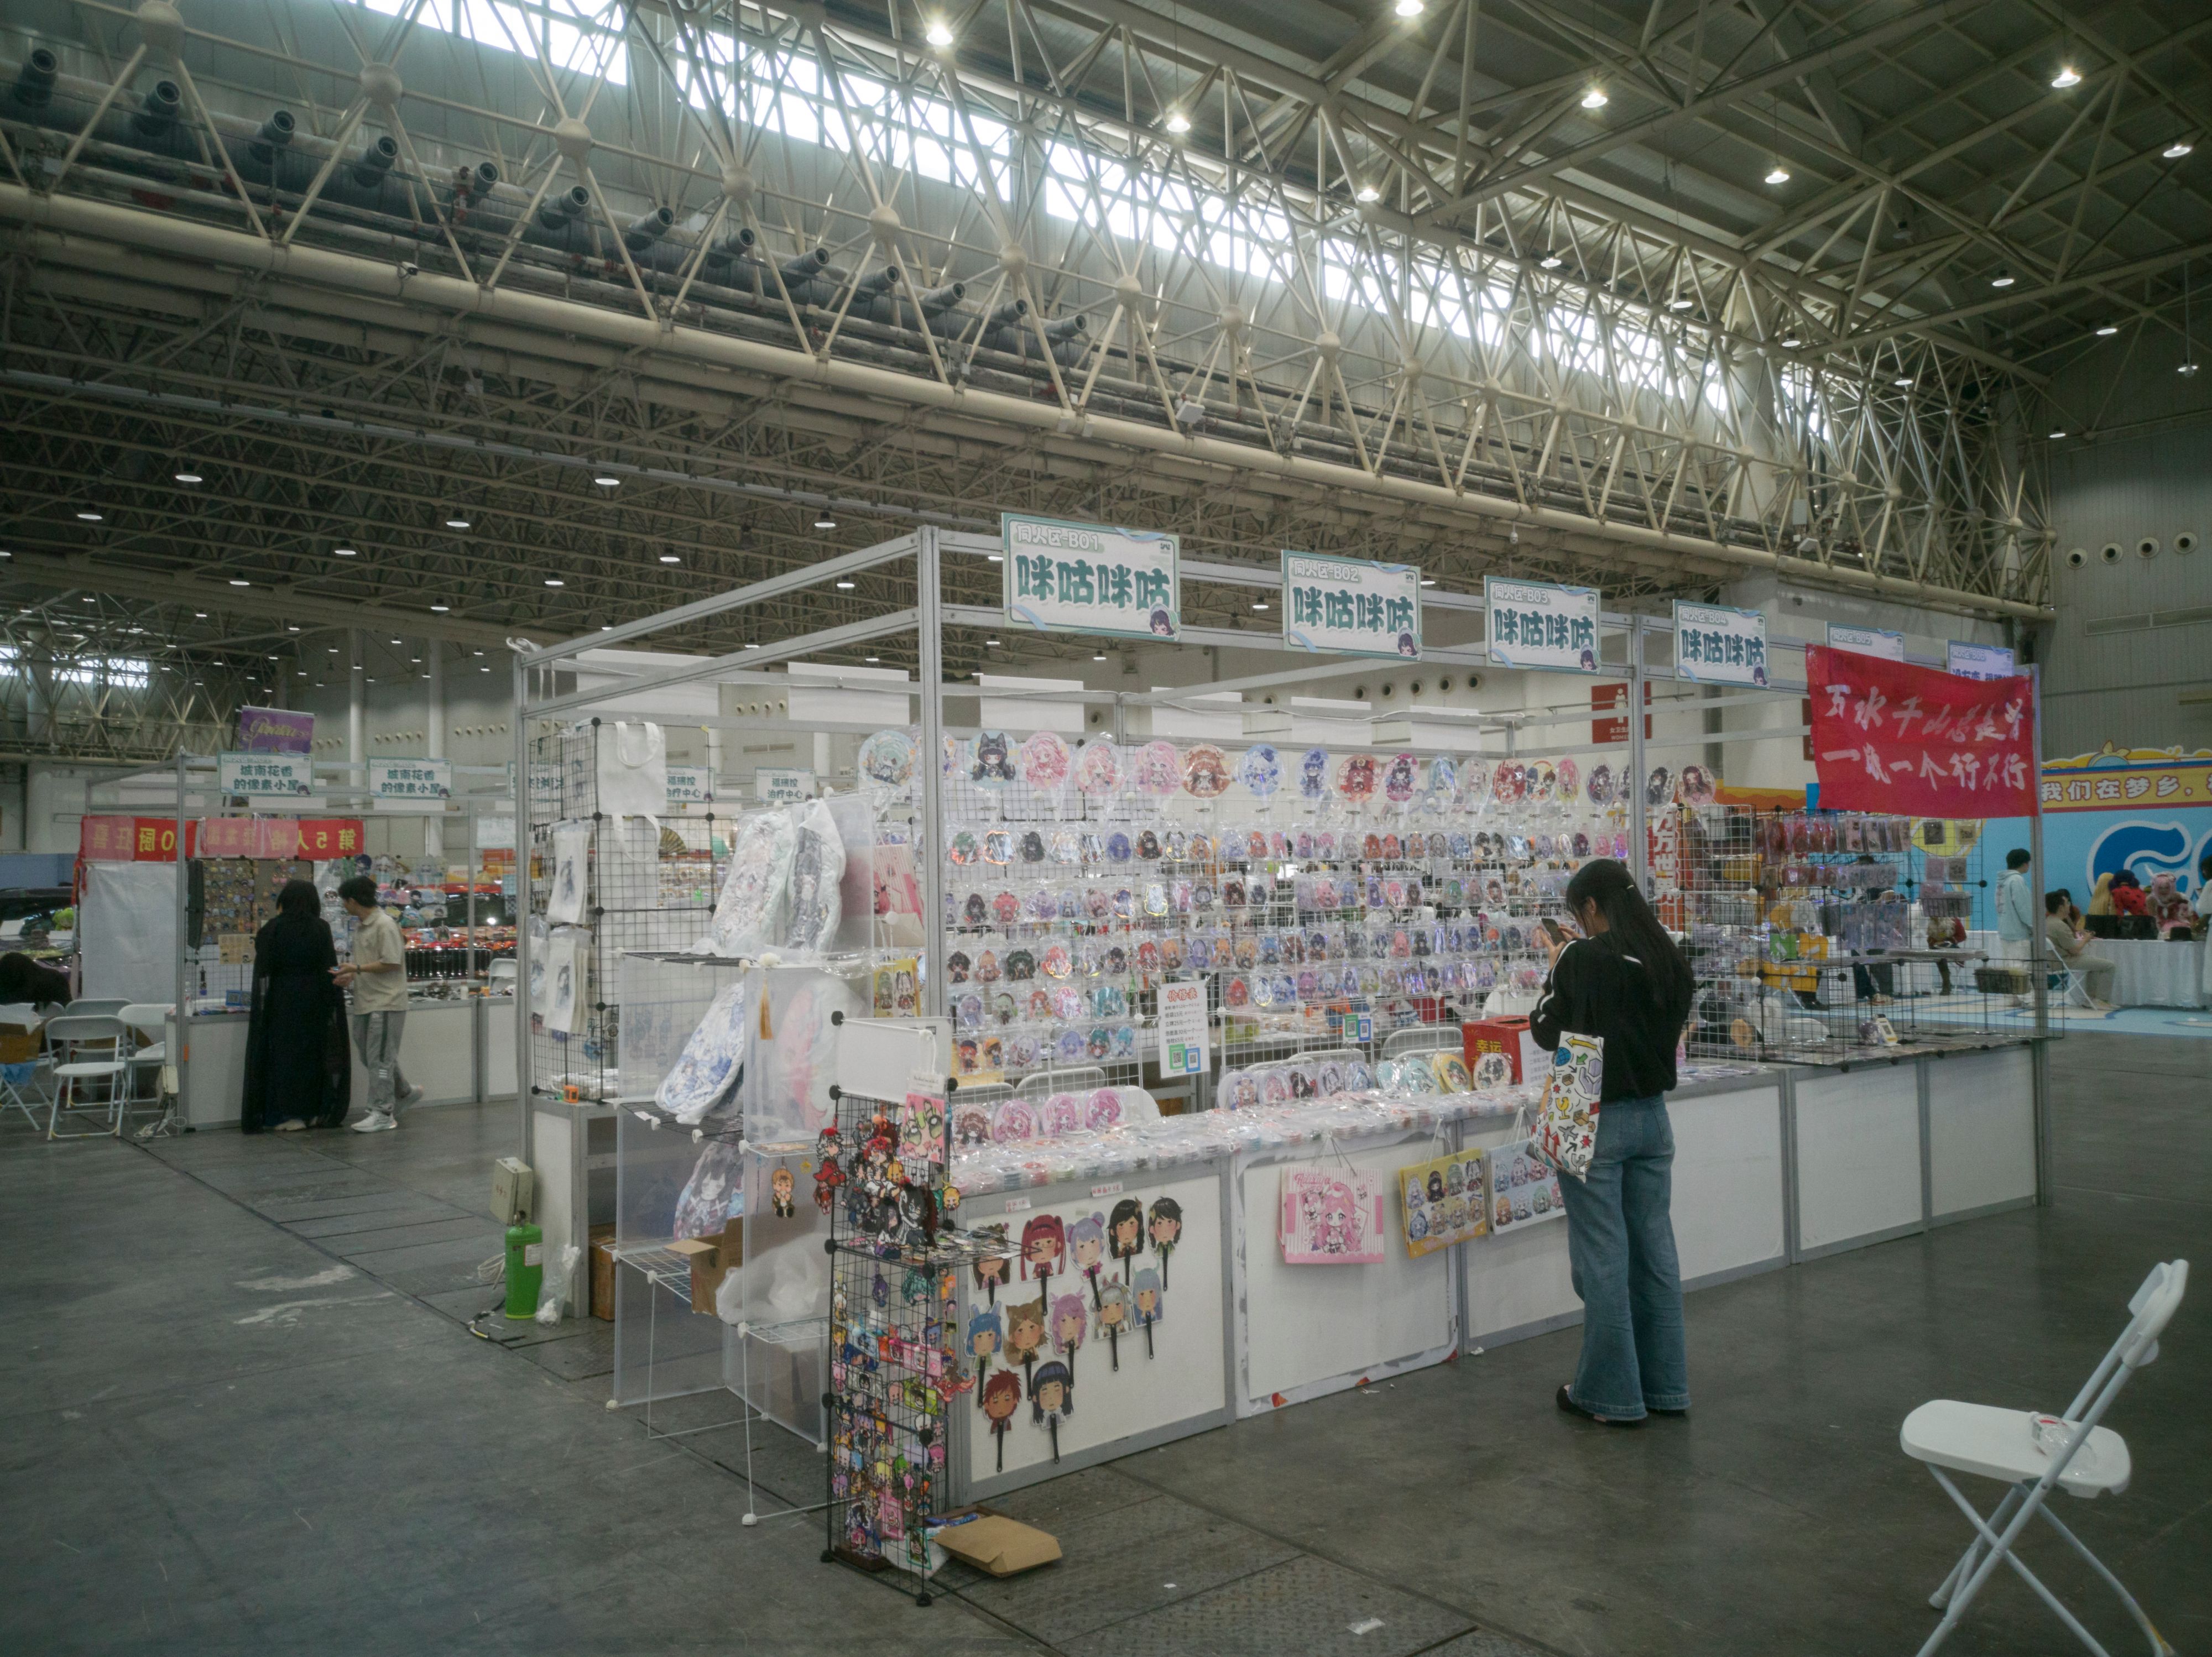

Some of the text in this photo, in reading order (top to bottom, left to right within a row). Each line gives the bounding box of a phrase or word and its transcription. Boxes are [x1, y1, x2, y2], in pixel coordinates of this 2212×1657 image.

[1016, 524, 1099, 551] 同人区-B01
[1293, 560, 1359, 582] 同人区-B02
[1016, 554, 1170, 610] 咪咕咪咕
[1494, 584, 1549, 604] 同人区-B03
[1292, 586, 1413, 635] 咪咕咪咕
[1681, 608, 1727, 625] 同人区-B04
[1494, 608, 1594, 651] 咪咕咪咕
[1681, 628, 1764, 667] 咪咕咪咕
[240, 764, 293, 777] 城南花香
[387, 769, 434, 781] 城南花香
[767, 789, 803, 798] 治疗中心
[2042, 773, 2212, 802] 我们在梦乡，
[1167, 987, 1198, 1002] 价格表
[1475, 1039, 1503, 1053] 幸运
